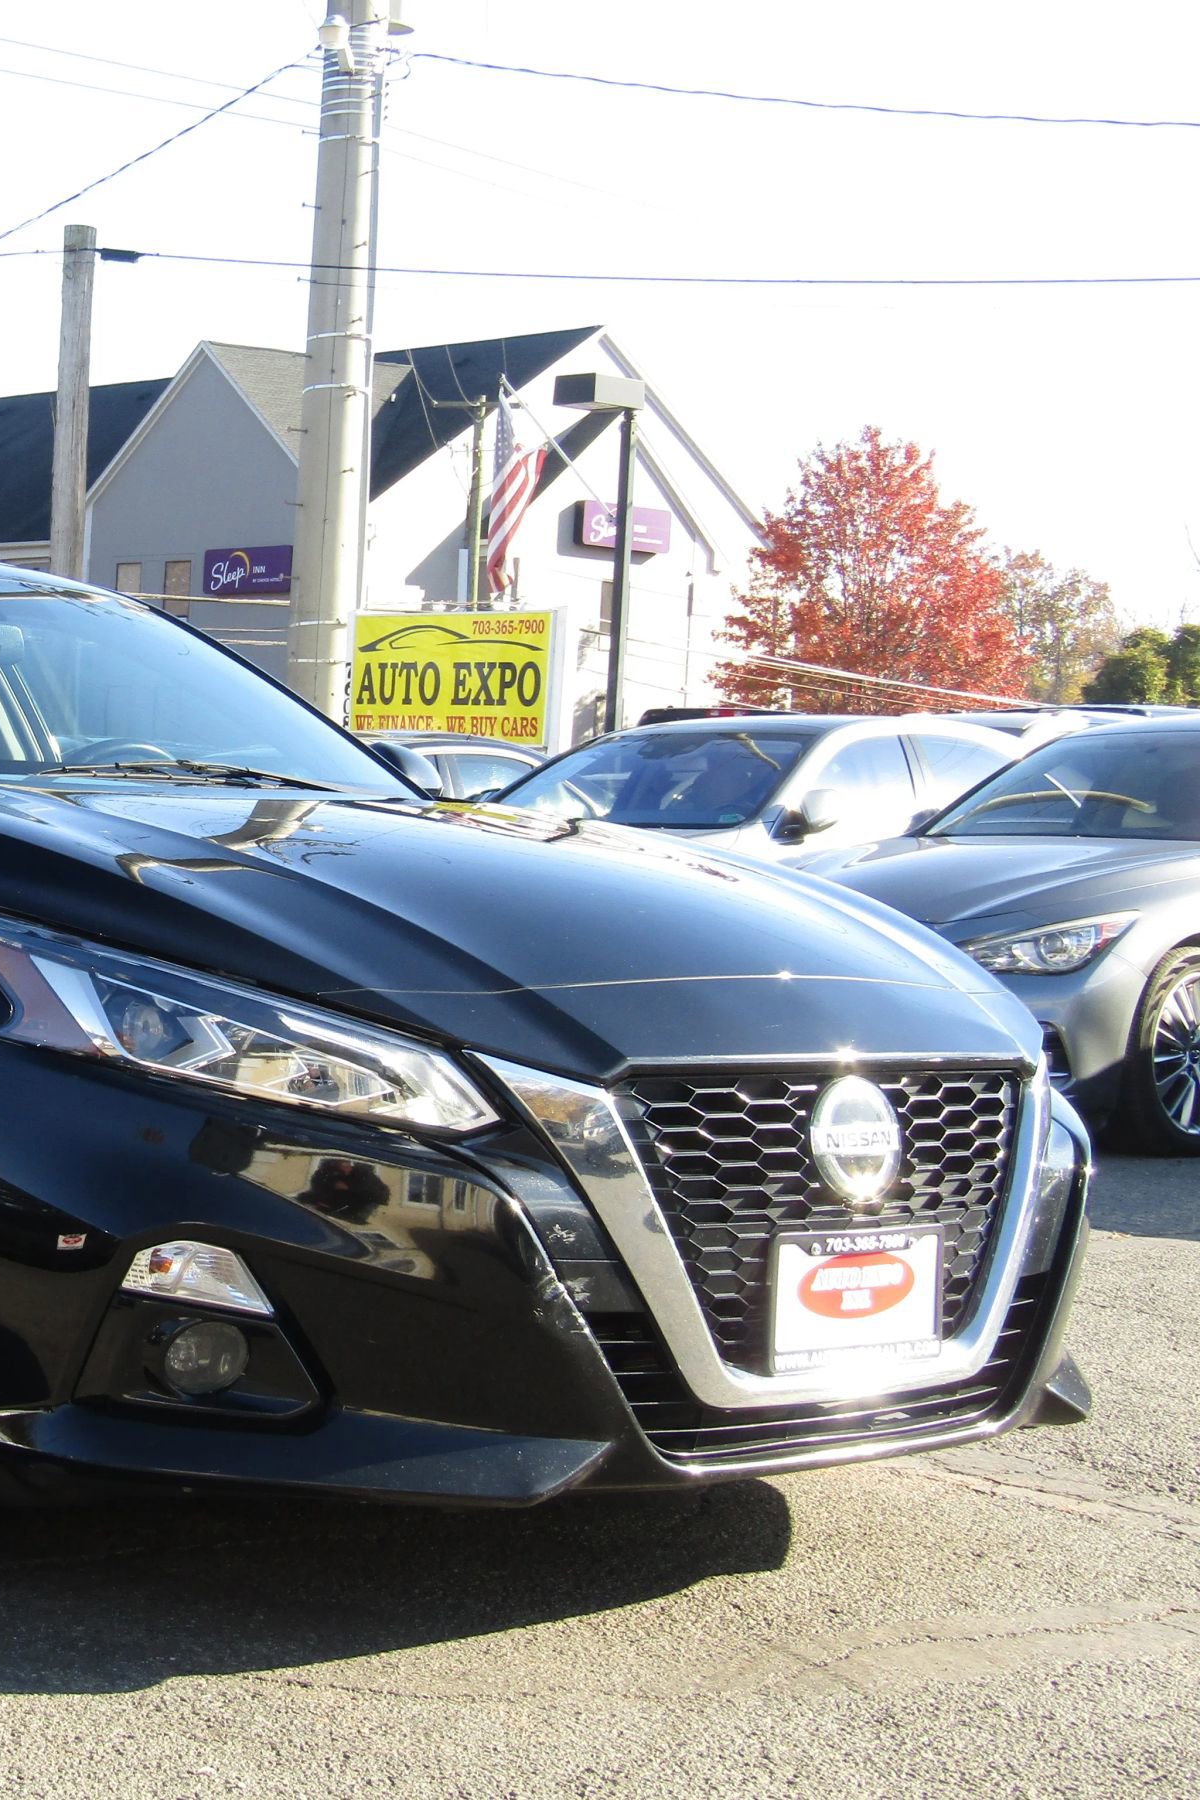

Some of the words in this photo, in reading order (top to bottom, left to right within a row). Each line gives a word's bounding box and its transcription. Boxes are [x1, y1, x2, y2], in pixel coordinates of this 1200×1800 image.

[210, 561, 246, 591] Sleep
[252, 565, 266, 574] INN
[472, 619, 545, 635] 703-365-7900
[356, 661, 441, 706] AUTO
[451, 661, 541, 708] EXPO
[355, 714, 375, 731] WE
[379, 714, 434, 731] FINANCE
[446, 715, 466, 734] WE
[471, 716, 498, 737] BUY
[501, 716, 538, 738] CARS
[826, 1130, 891, 1149] NISSAN
